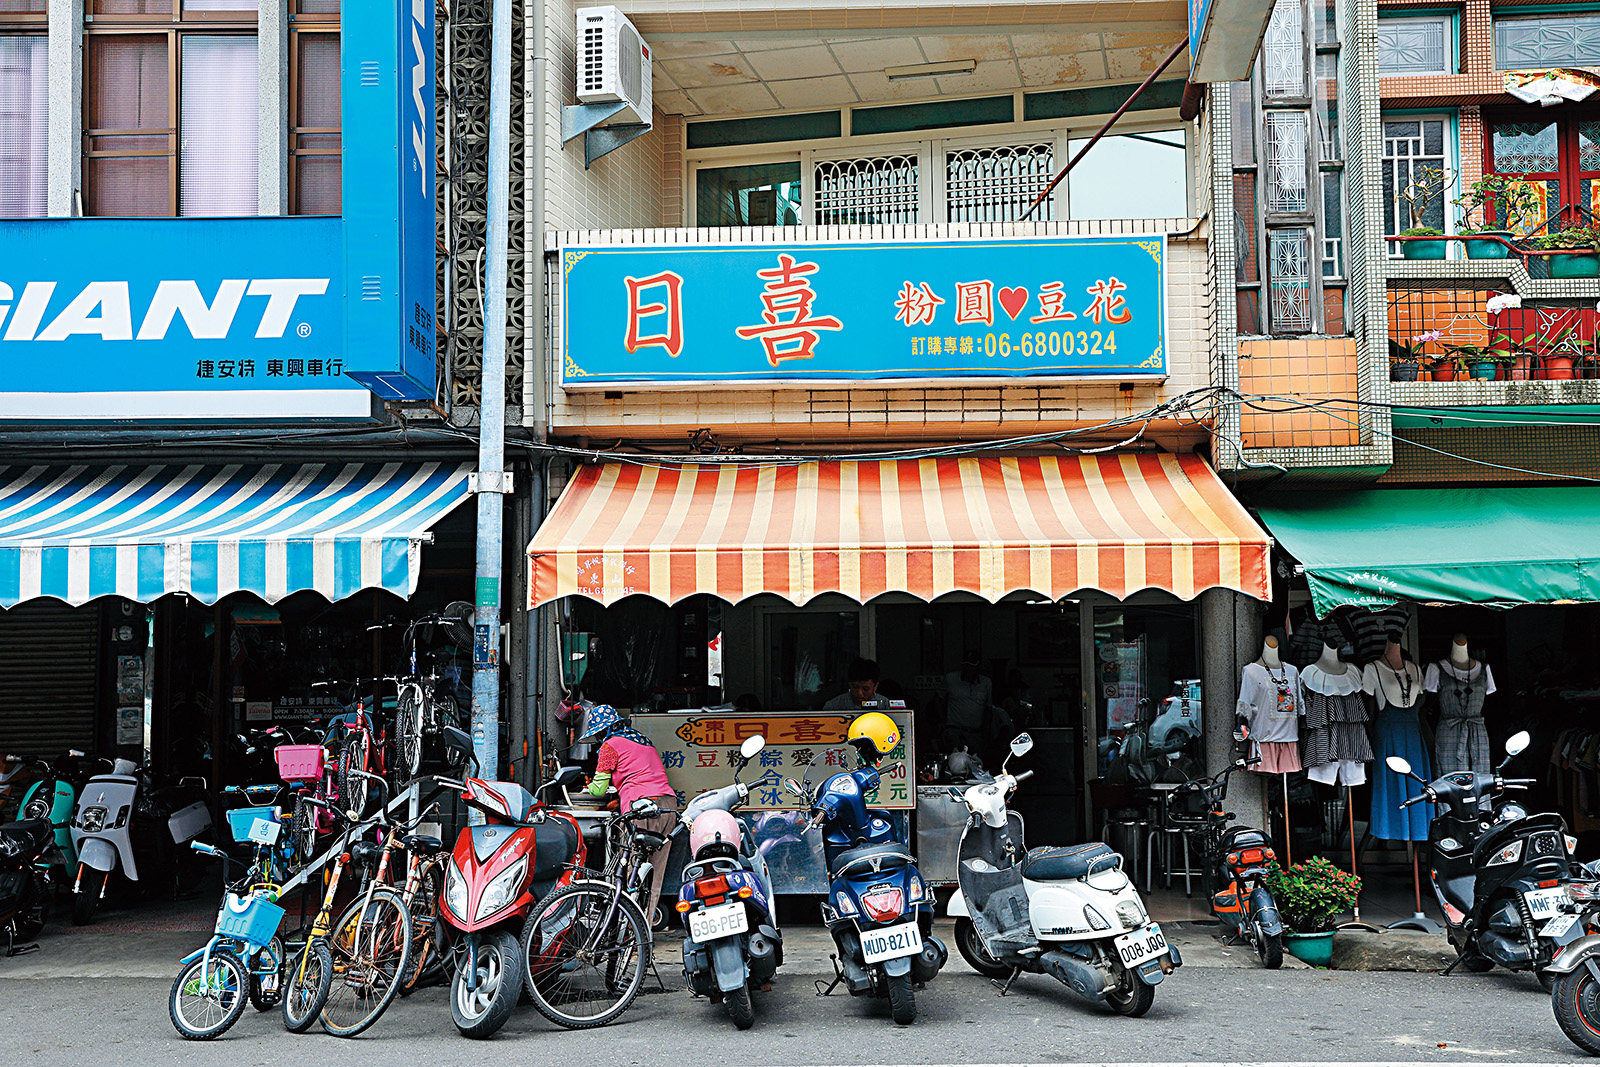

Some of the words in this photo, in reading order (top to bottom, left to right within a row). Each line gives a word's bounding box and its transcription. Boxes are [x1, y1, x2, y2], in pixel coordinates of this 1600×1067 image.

[0, 278, 330, 341] IANT
[196, 359, 255, 378] 捷安特
[266, 358, 343, 377] 東興車行
[692, 912, 744, 937] 696-PEF
[863, 930, 918, 956] MUD-8211
